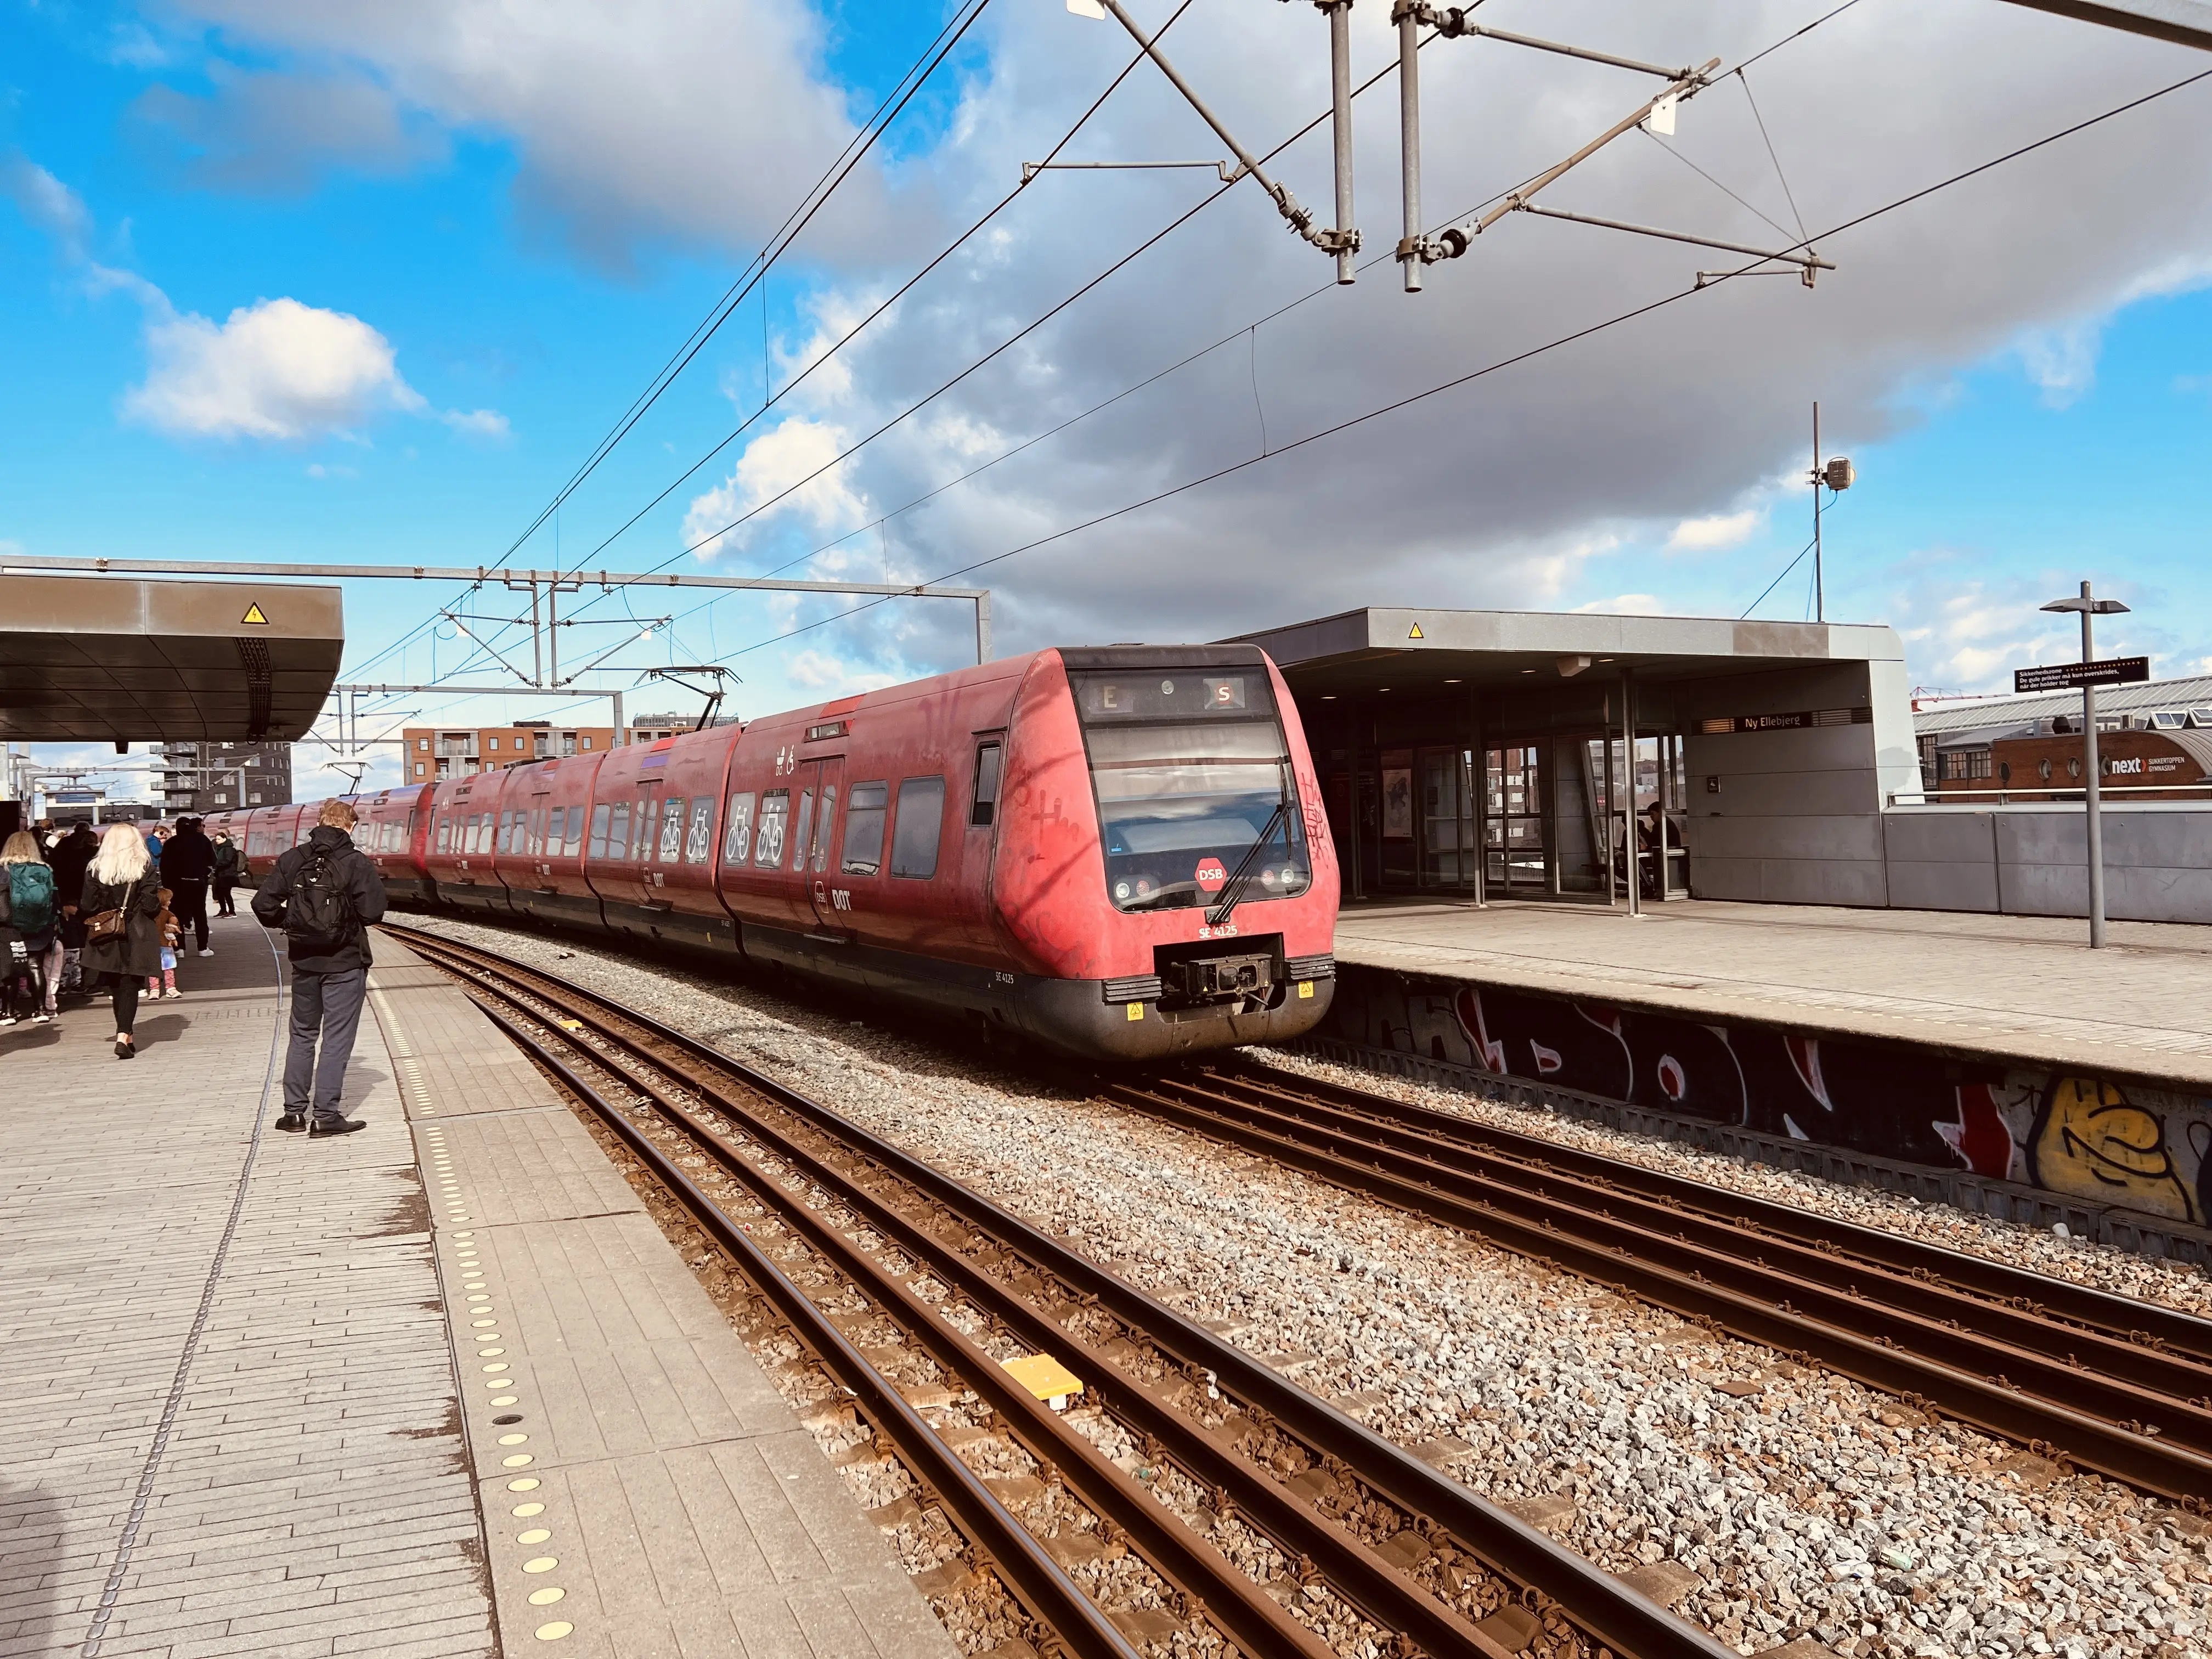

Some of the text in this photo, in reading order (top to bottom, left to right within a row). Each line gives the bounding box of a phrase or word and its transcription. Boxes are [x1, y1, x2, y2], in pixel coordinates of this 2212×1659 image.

[2019, 669, 2062, 677] Sikkerhedszone
[1103, 686, 1118, 708] E
[1218, 686, 1230, 701] S
[1745, 715, 1801, 730] Ny Ellebjerg
[2112, 757, 2141, 774] next
[2148, 757, 2185, 765] SUKKERTOPPEN
[1199, 868, 1223, 881] DSB
[832, 889, 851, 911] DOT
[1199, 925, 1238, 939] SE 4125
[995, 971, 1014, 984] SE 4125
